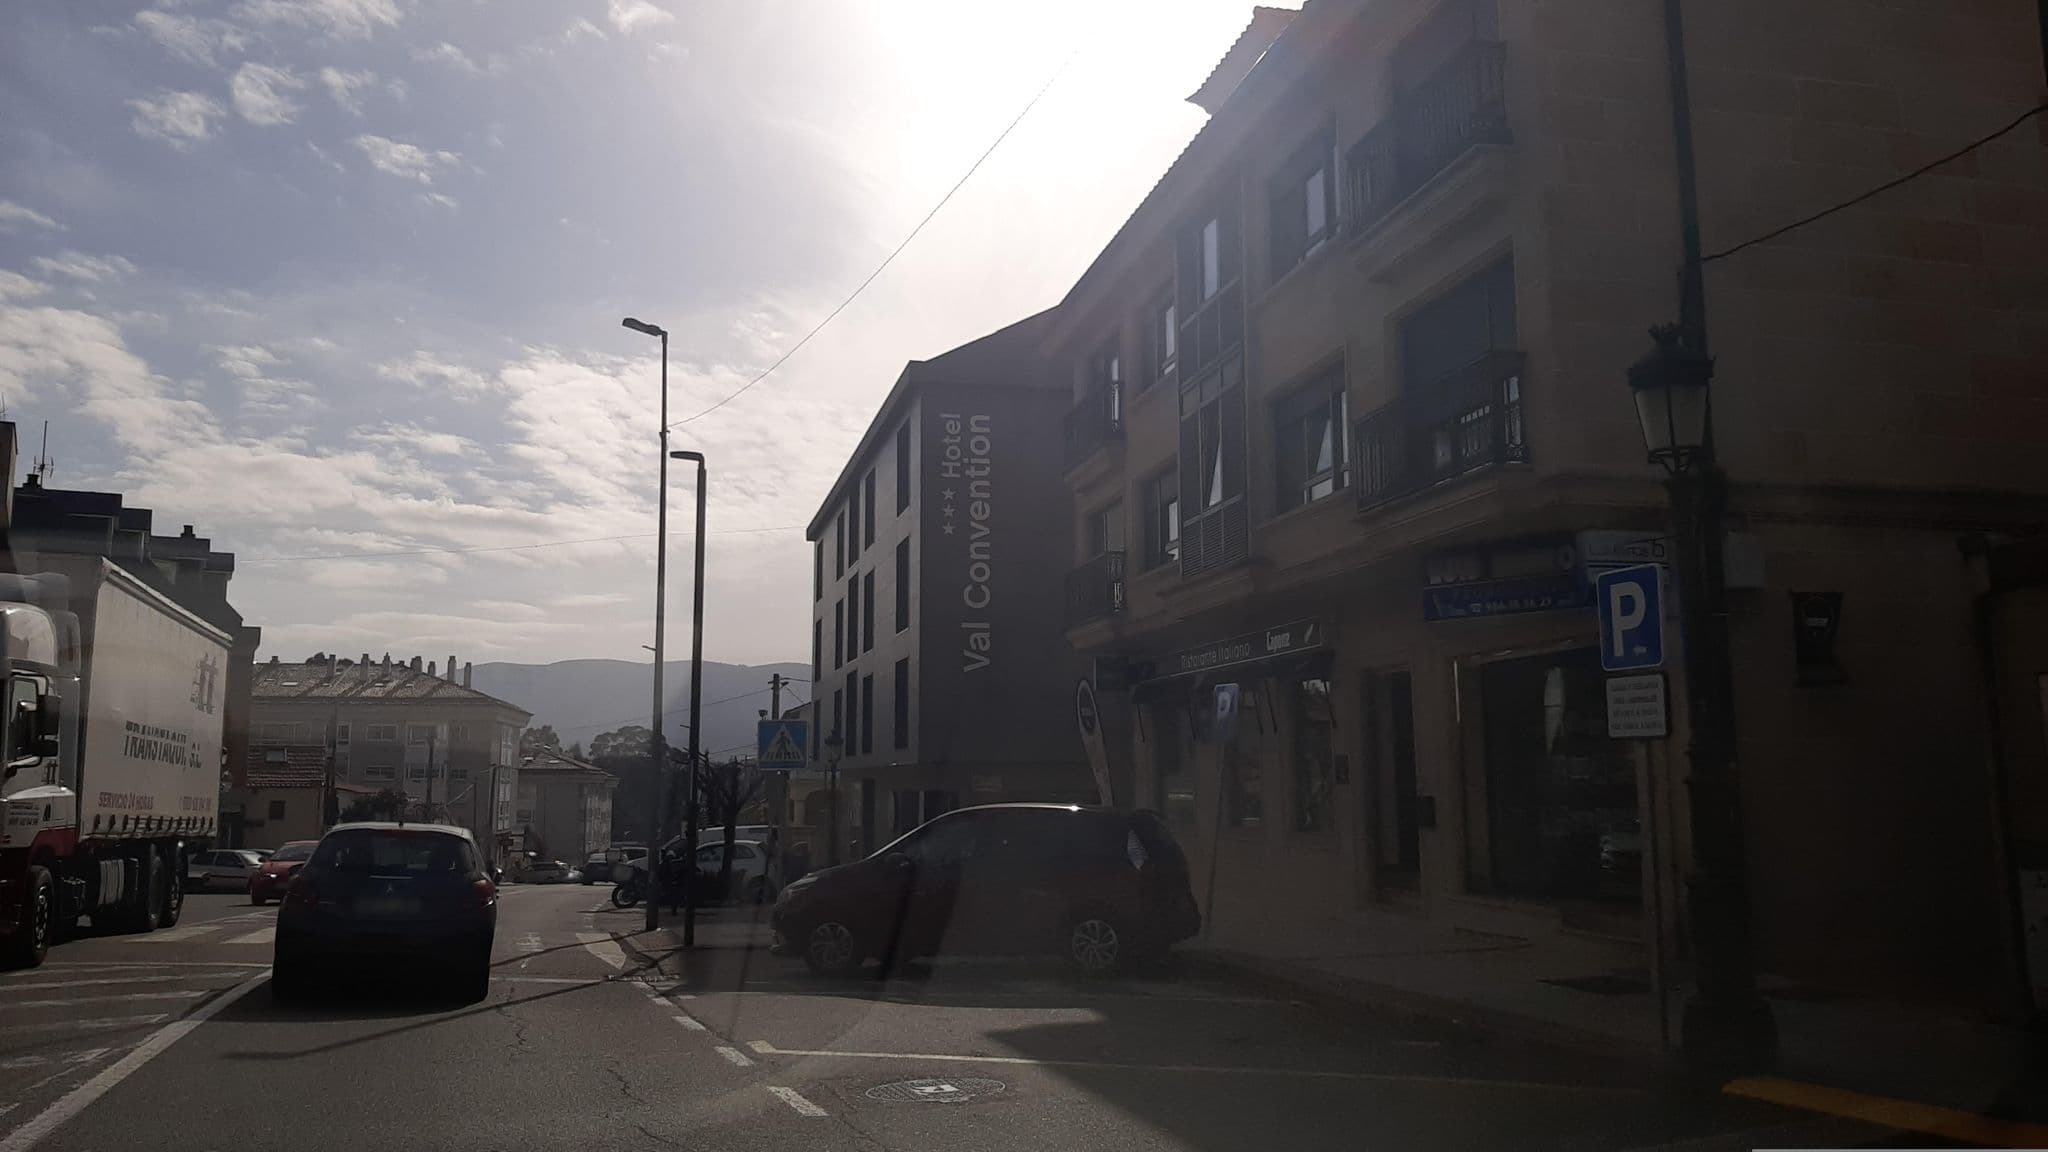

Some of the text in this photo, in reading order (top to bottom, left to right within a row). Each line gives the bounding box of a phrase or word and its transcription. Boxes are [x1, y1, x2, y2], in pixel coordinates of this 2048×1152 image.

[940, 413, 962, 478] Hotel
[960, 414, 992, 673] Val Convention
[1218, 643, 1250, 663] Italiano
[1609, 580, 1647, 658] P
